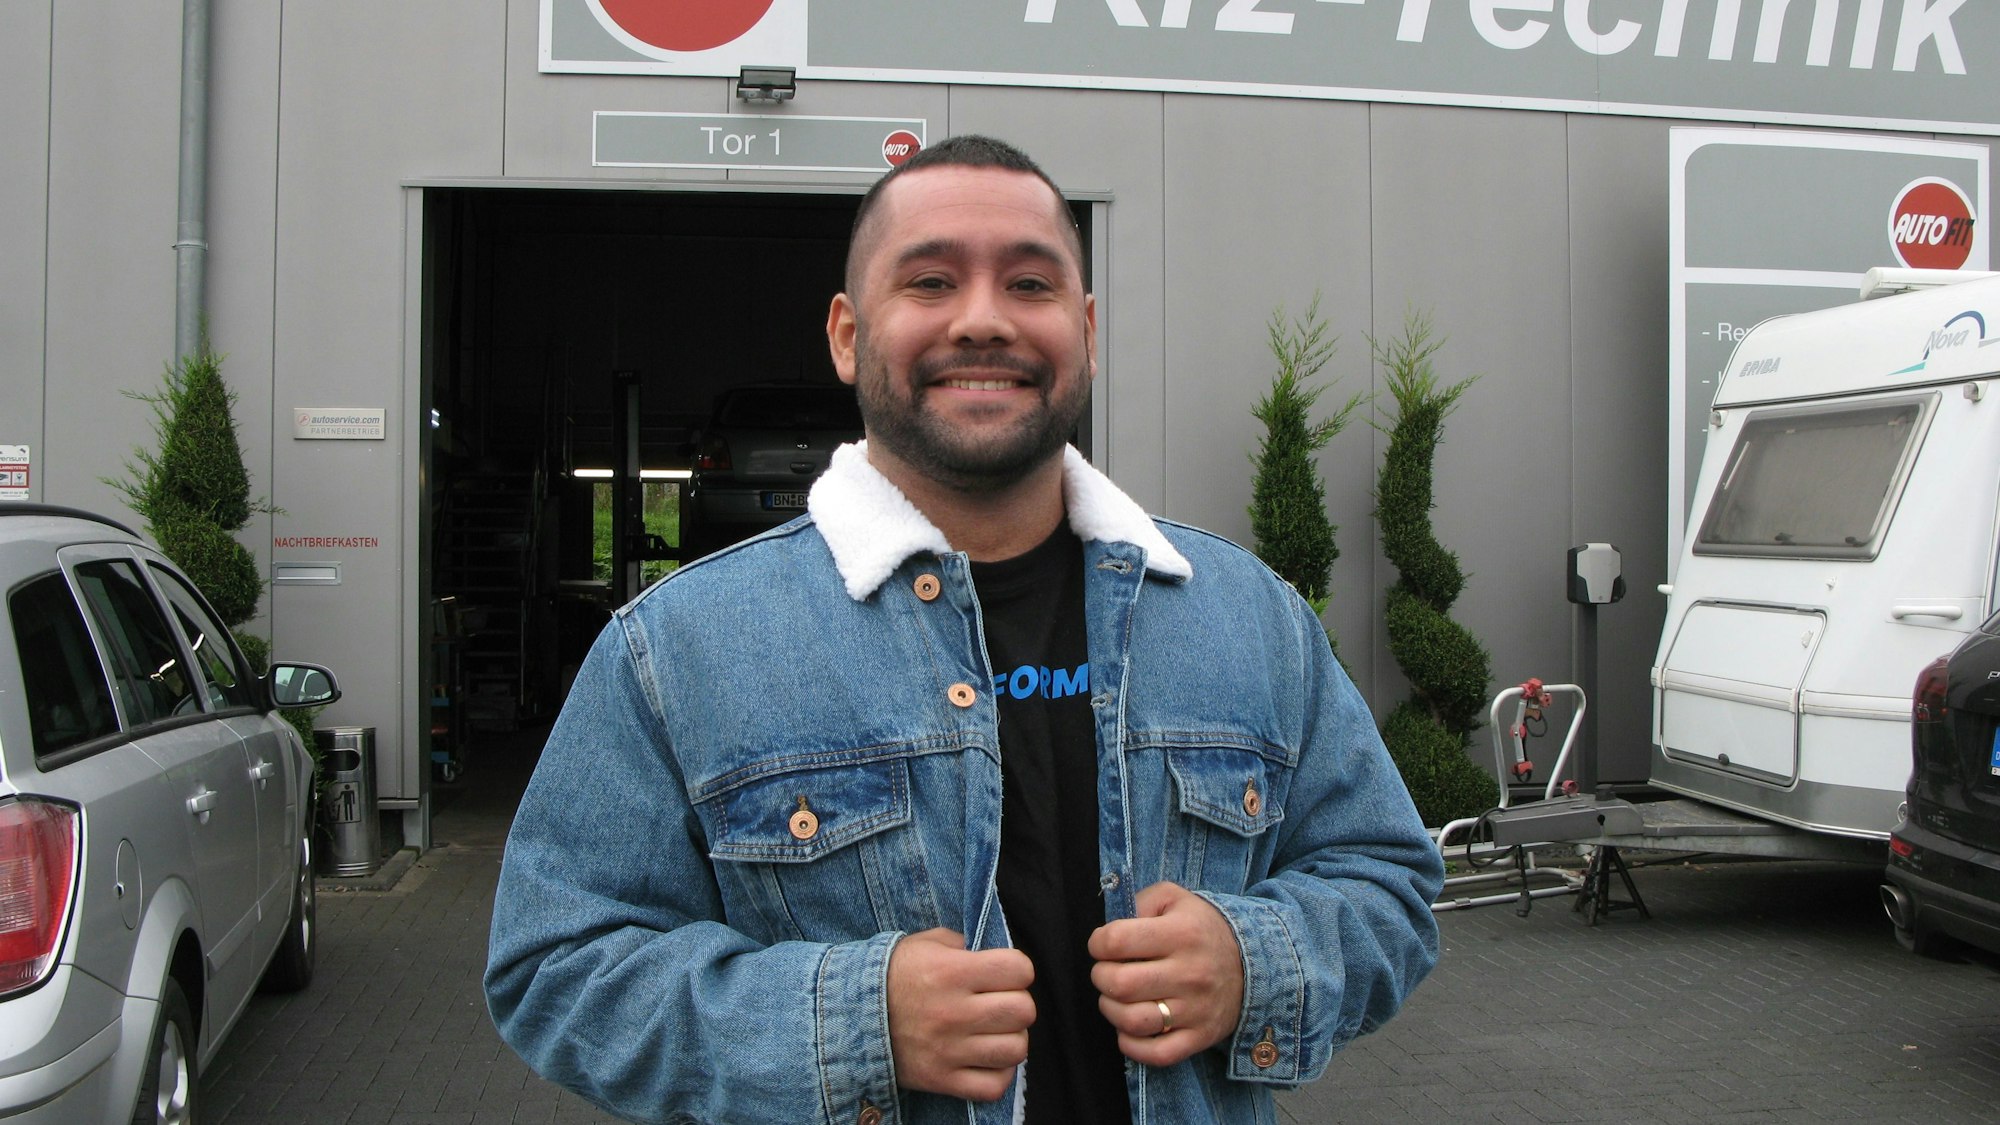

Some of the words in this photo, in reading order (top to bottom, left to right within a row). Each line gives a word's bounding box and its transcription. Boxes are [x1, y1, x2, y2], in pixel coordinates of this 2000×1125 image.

[700, 126, 757, 155] Tor
[768, 128, 780, 156] 1
[1718, 322, 1752, 341] Re
[1923, 330, 1969, 352] Nova
[1739, 357, 1781, 377] ERIBA
[311, 415, 380, 424] autoservice.com
[310, 427, 380, 435] PARTNERBETRIEB
[774, 494, 790, 506] BN
[274, 537, 379, 548] NACHTBRIEFKASTEN
